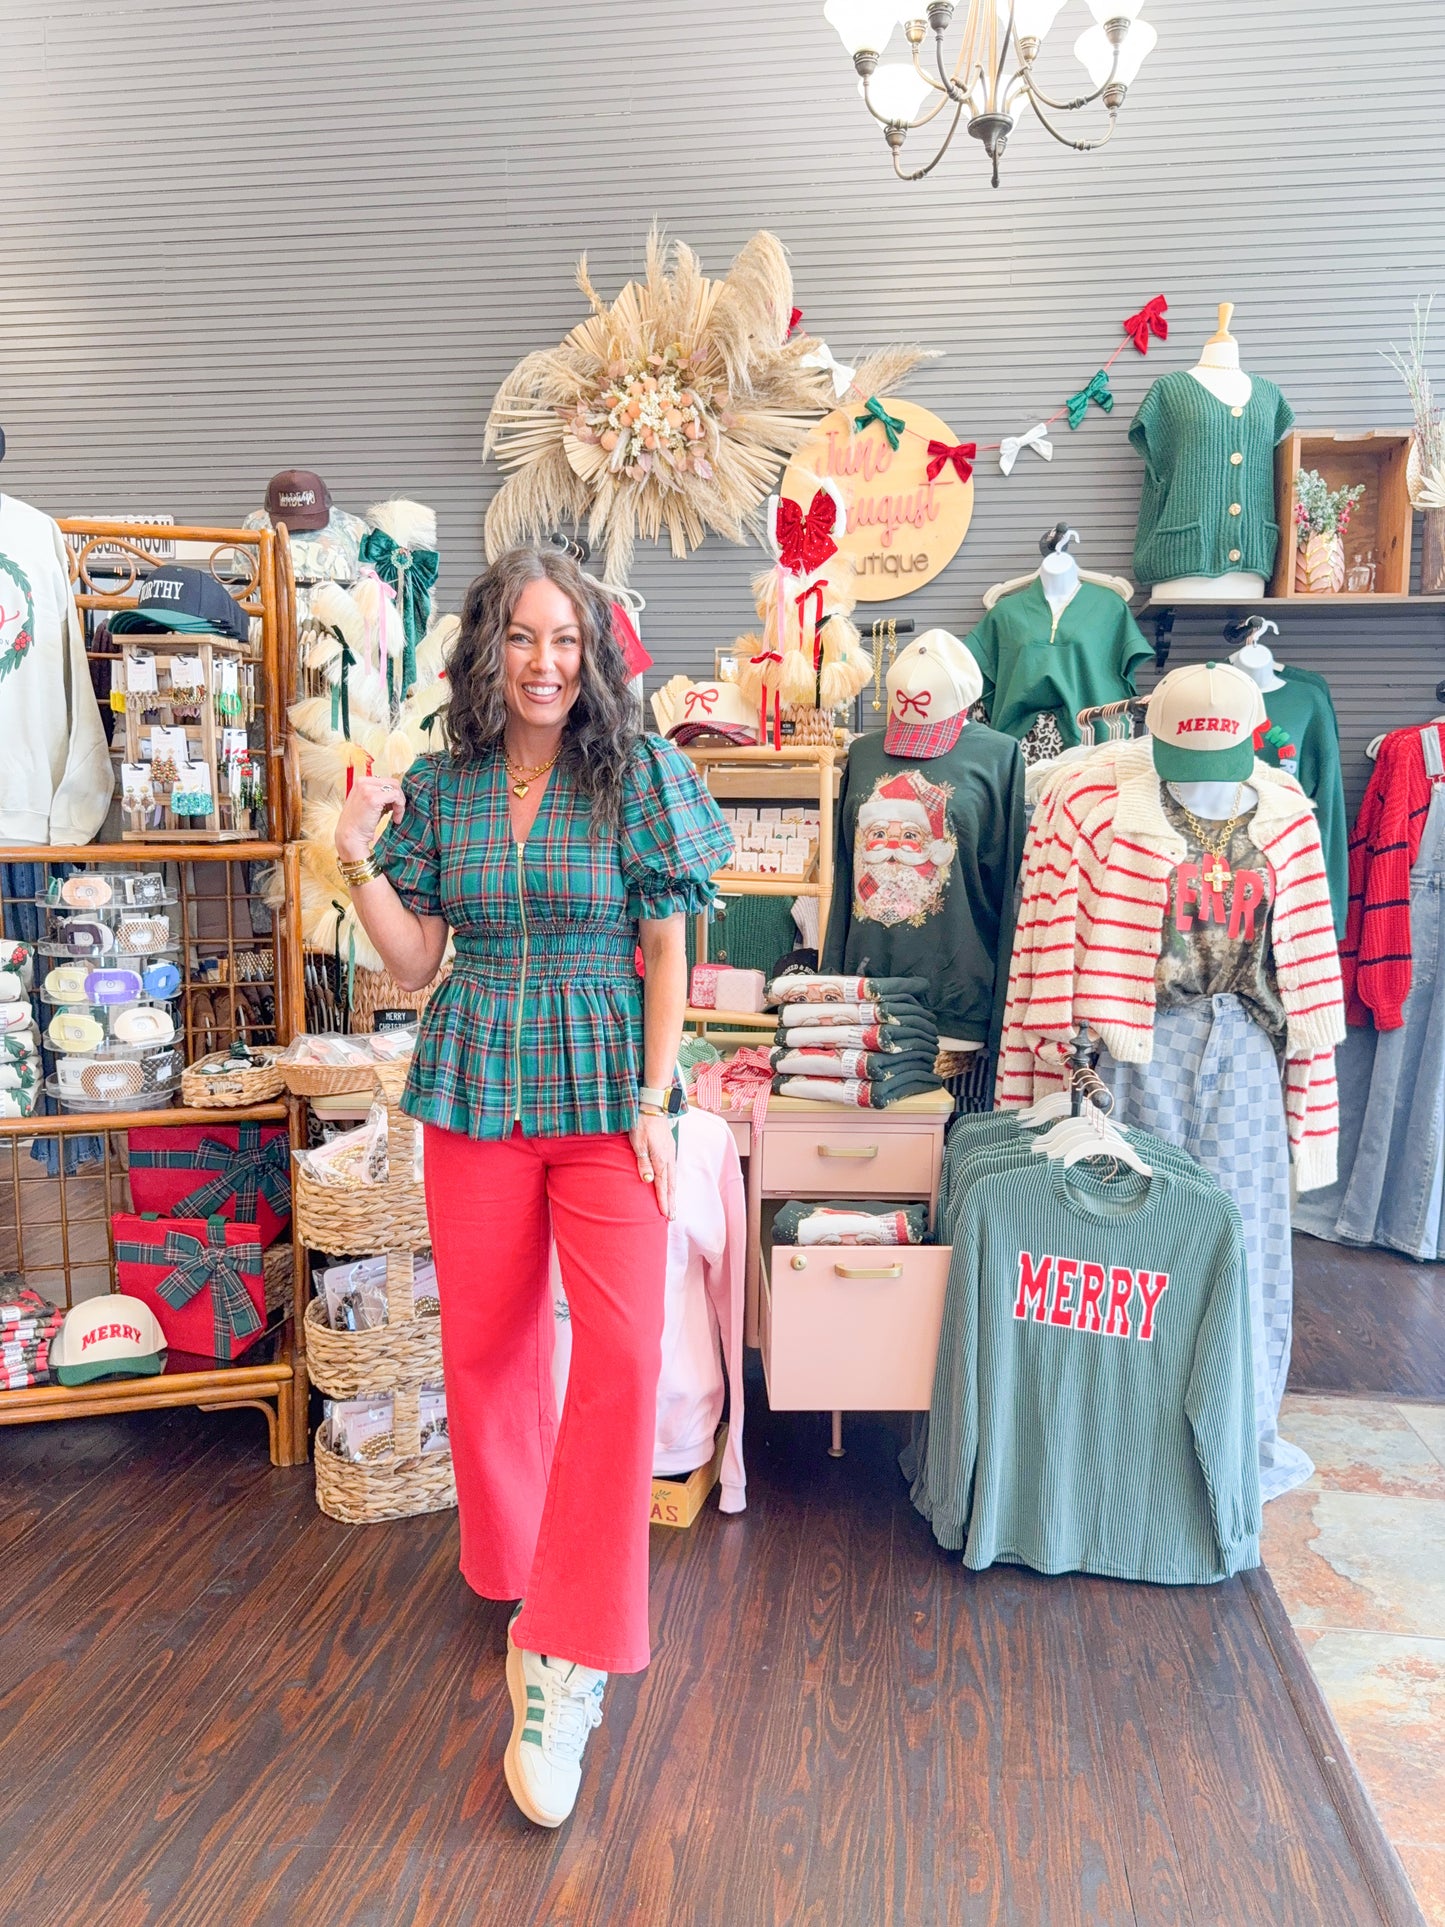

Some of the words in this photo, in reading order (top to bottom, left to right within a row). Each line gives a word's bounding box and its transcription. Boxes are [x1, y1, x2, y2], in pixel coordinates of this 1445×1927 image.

[816, 431, 892, 481] June
[855, 552, 929, 577] utique
[1176, 718, 1240, 735] MERRY
[1164, 853, 1277, 941] ERR
[385, 1012, 406, 1021] MERRY
[1013, 1250, 1170, 1341] MERRY
[82, 1323, 142, 1351] MERRY
